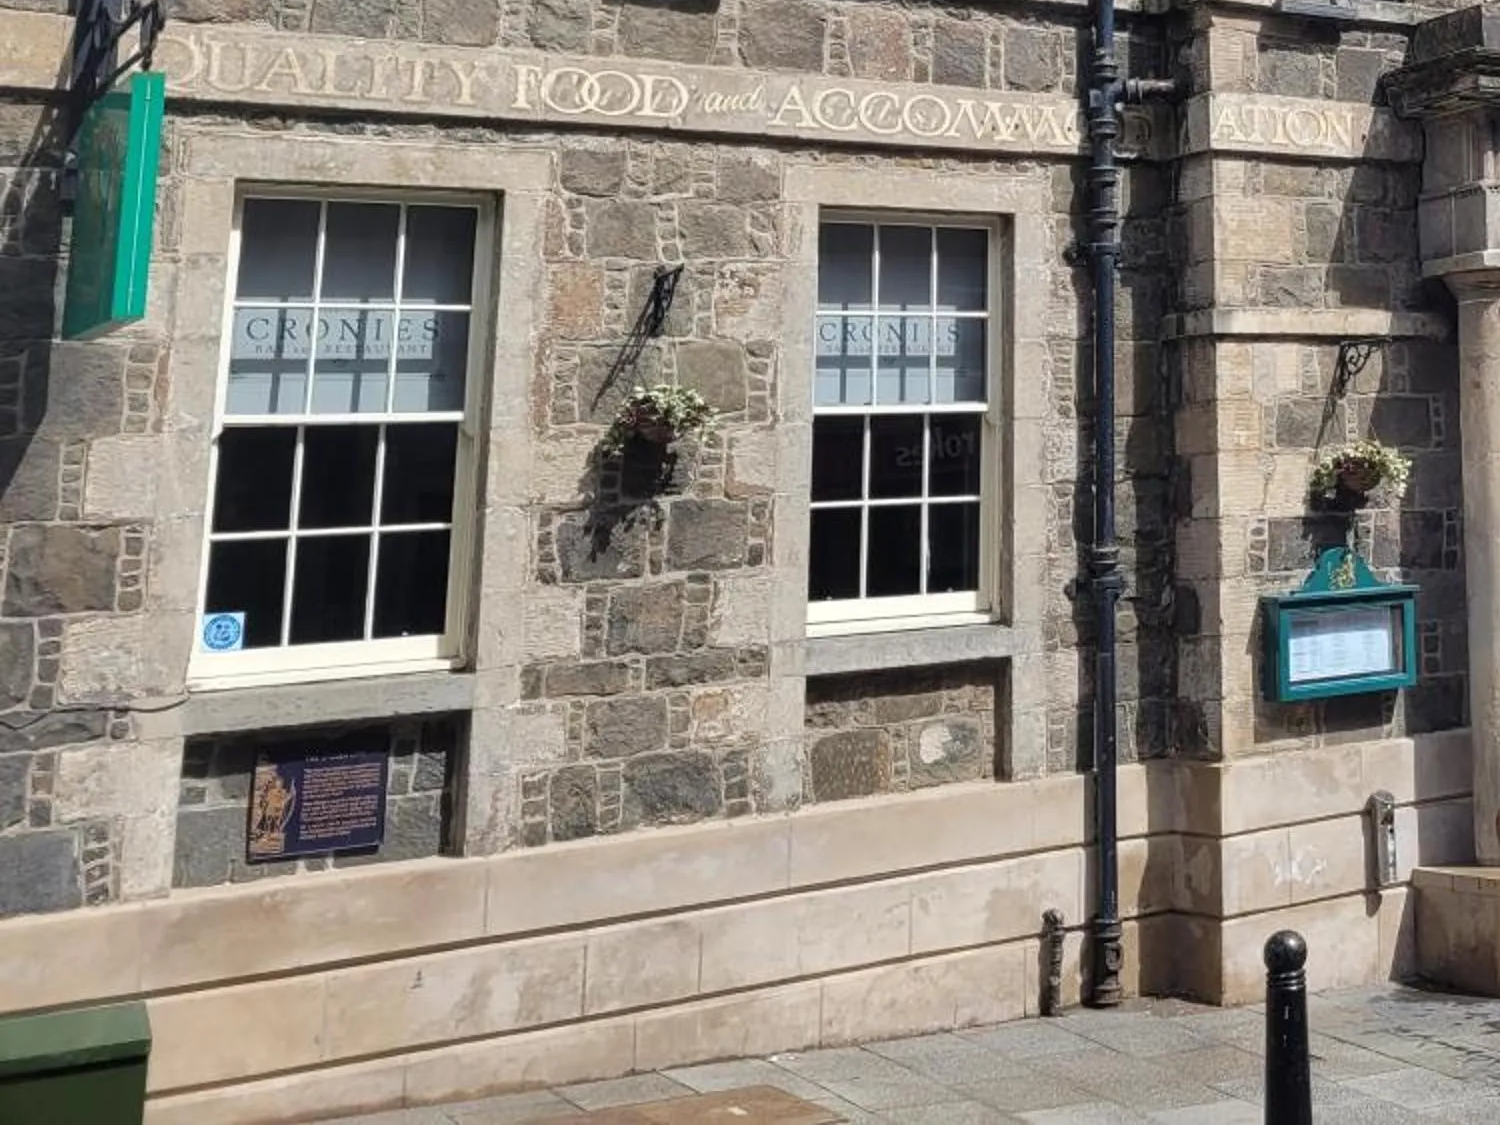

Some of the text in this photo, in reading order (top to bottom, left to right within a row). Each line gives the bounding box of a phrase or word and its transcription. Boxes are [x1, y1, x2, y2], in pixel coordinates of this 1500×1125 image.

[153, 33, 478, 105] QUALITY
[511, 64, 690, 117] FOOD
[703, 82, 766, 114] and
[246, 318, 439, 341] CRONIES
[819, 322, 960, 343] CRONIS
